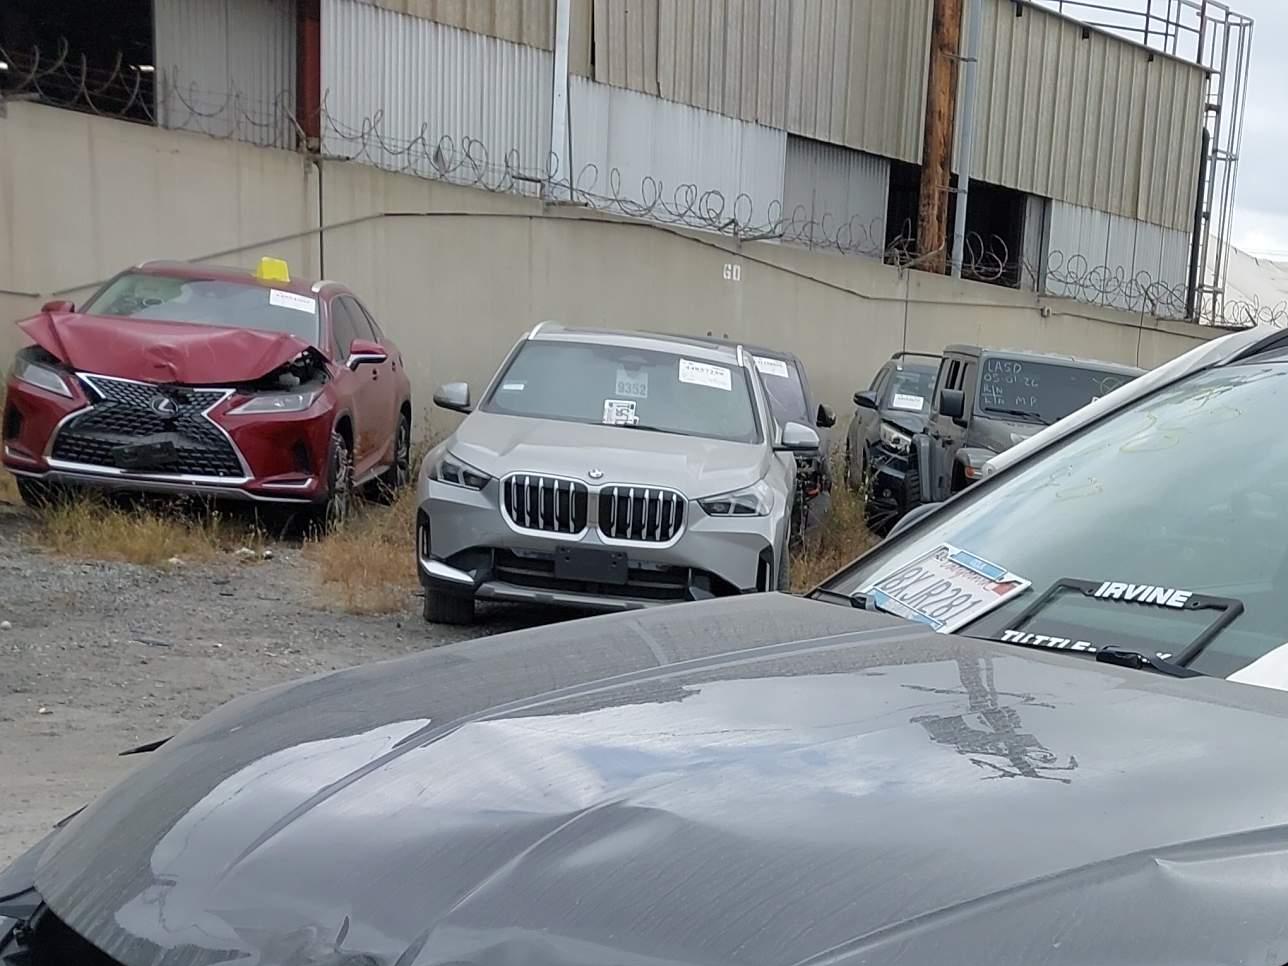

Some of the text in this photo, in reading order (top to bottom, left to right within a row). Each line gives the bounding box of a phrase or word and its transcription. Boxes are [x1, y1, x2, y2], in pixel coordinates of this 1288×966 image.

[988, 360, 1022, 374] LASD
[882, 567, 983, 621] 8XJR281
[1094, 581, 1193, 608] IRVINE
